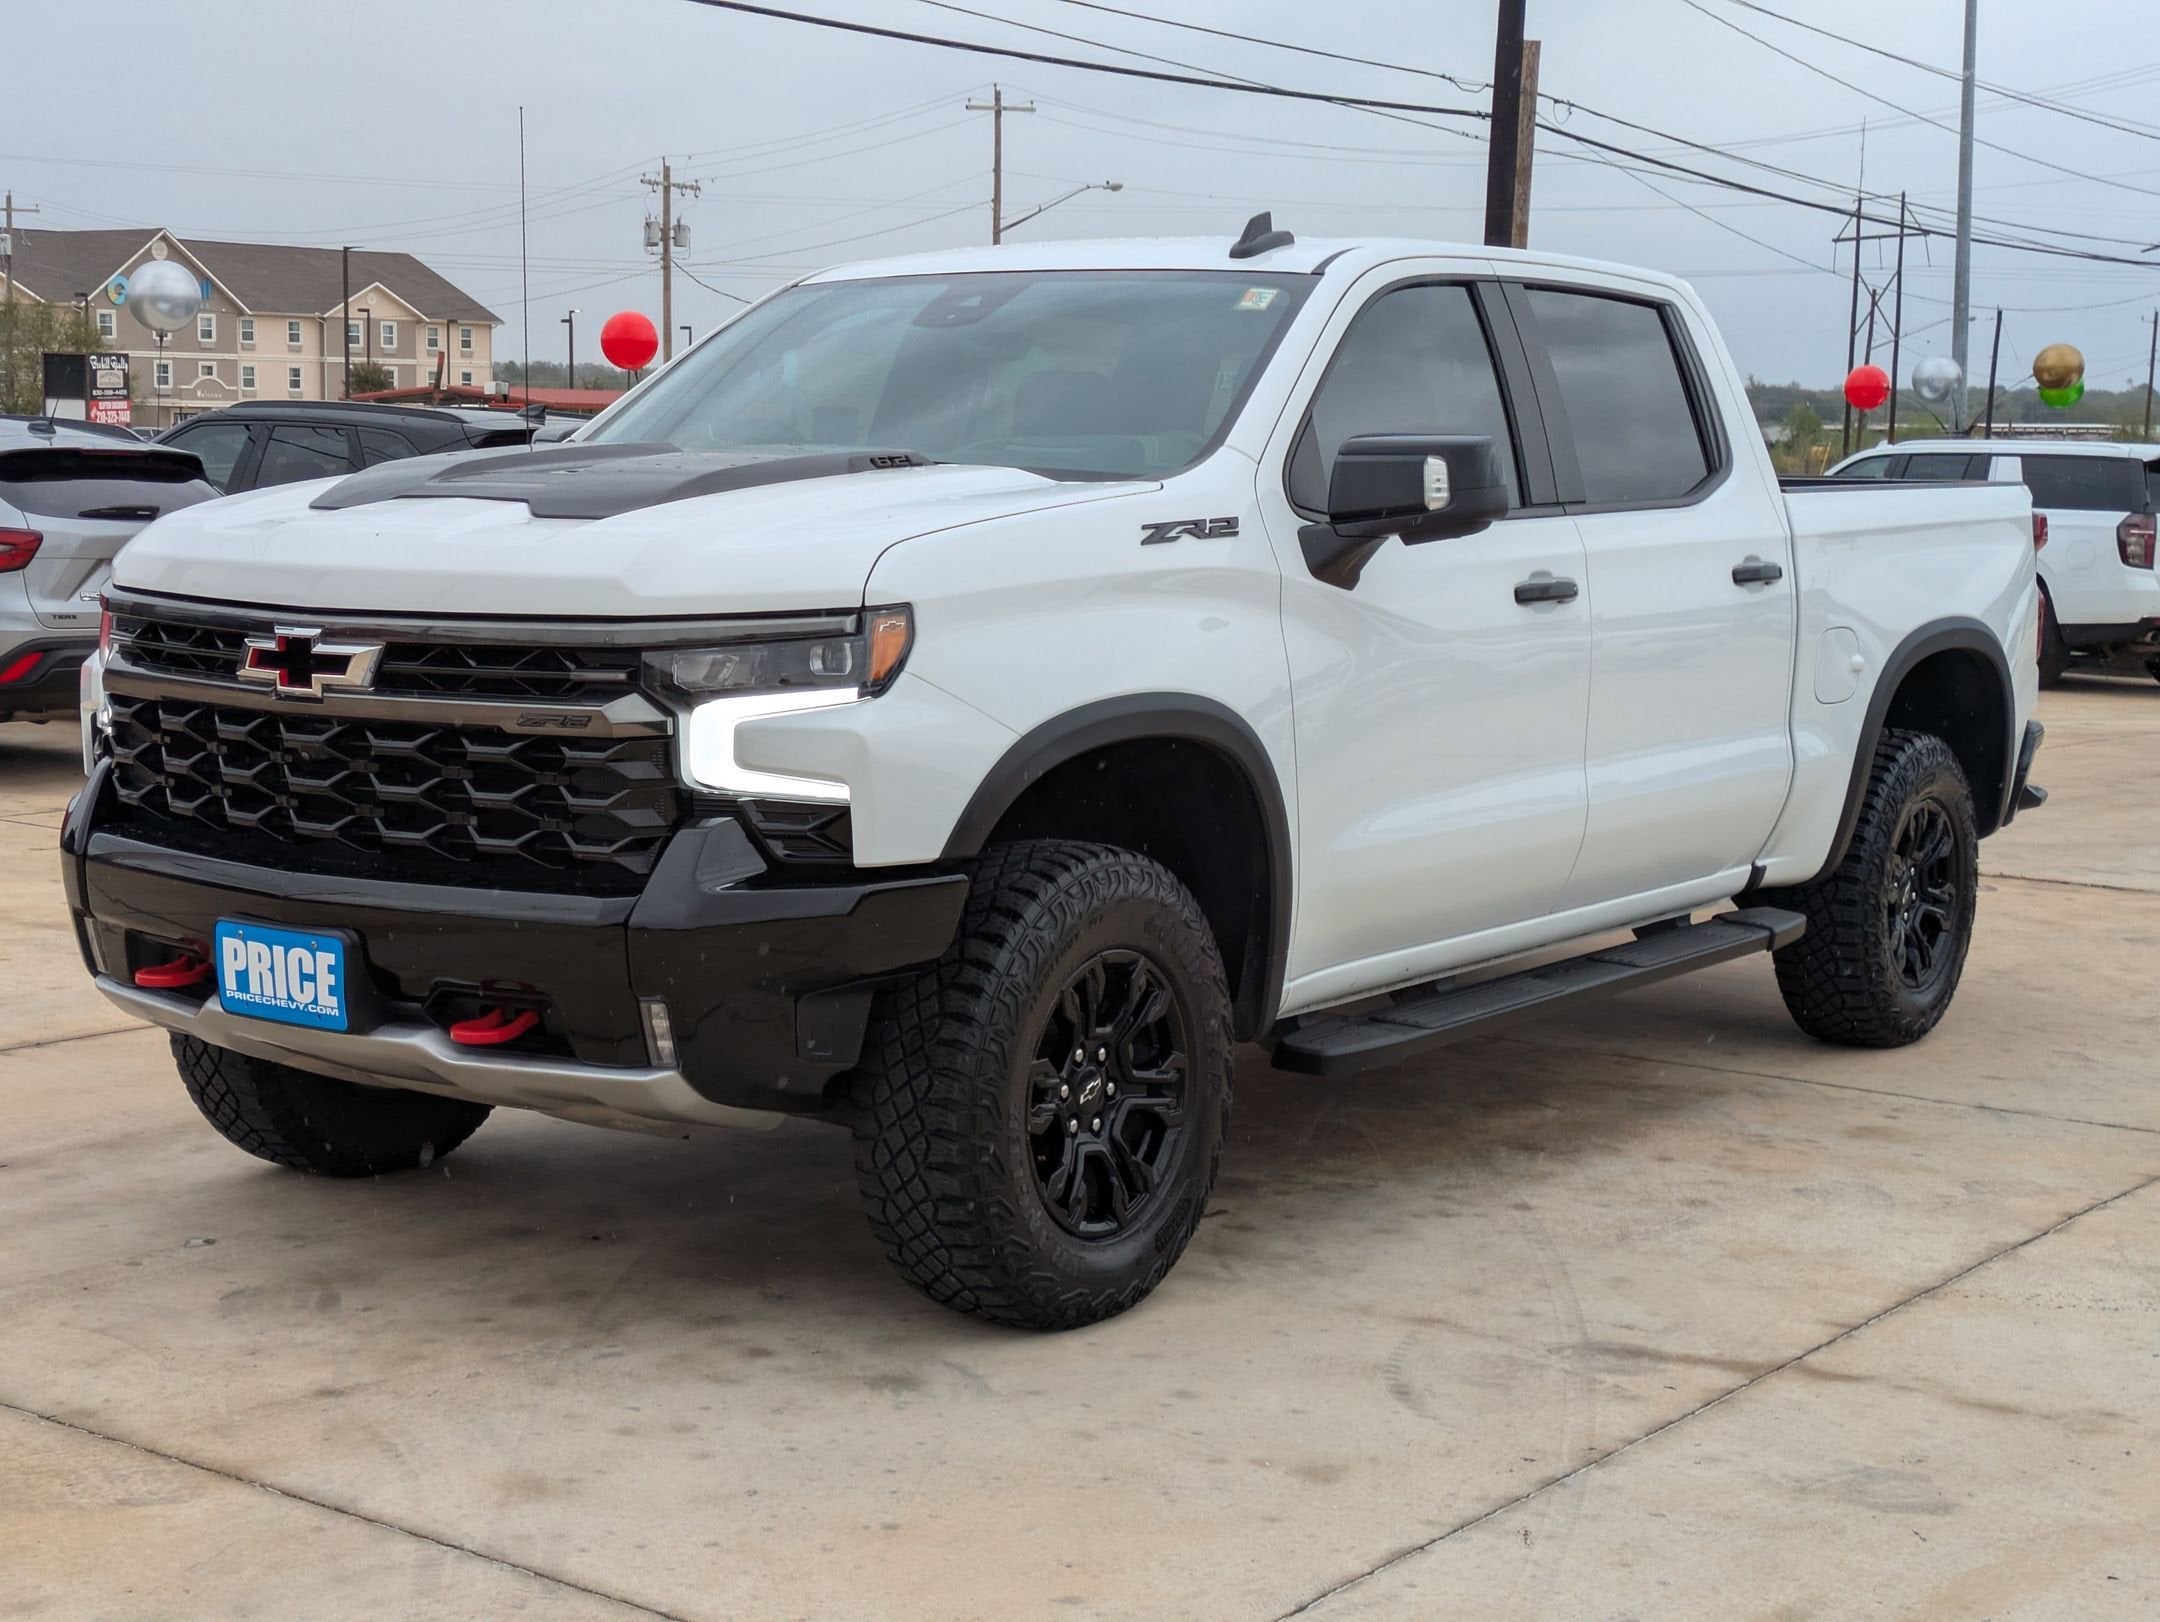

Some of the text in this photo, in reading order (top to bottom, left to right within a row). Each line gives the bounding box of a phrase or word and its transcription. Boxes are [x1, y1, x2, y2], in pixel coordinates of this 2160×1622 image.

[1140, 516, 1240, 546] ZR2
[516, 712, 592, 729] ZR2
[222, 936, 338, 1008] PRICE
[226, 990, 339, 1017] PRICECHEVY.COM
